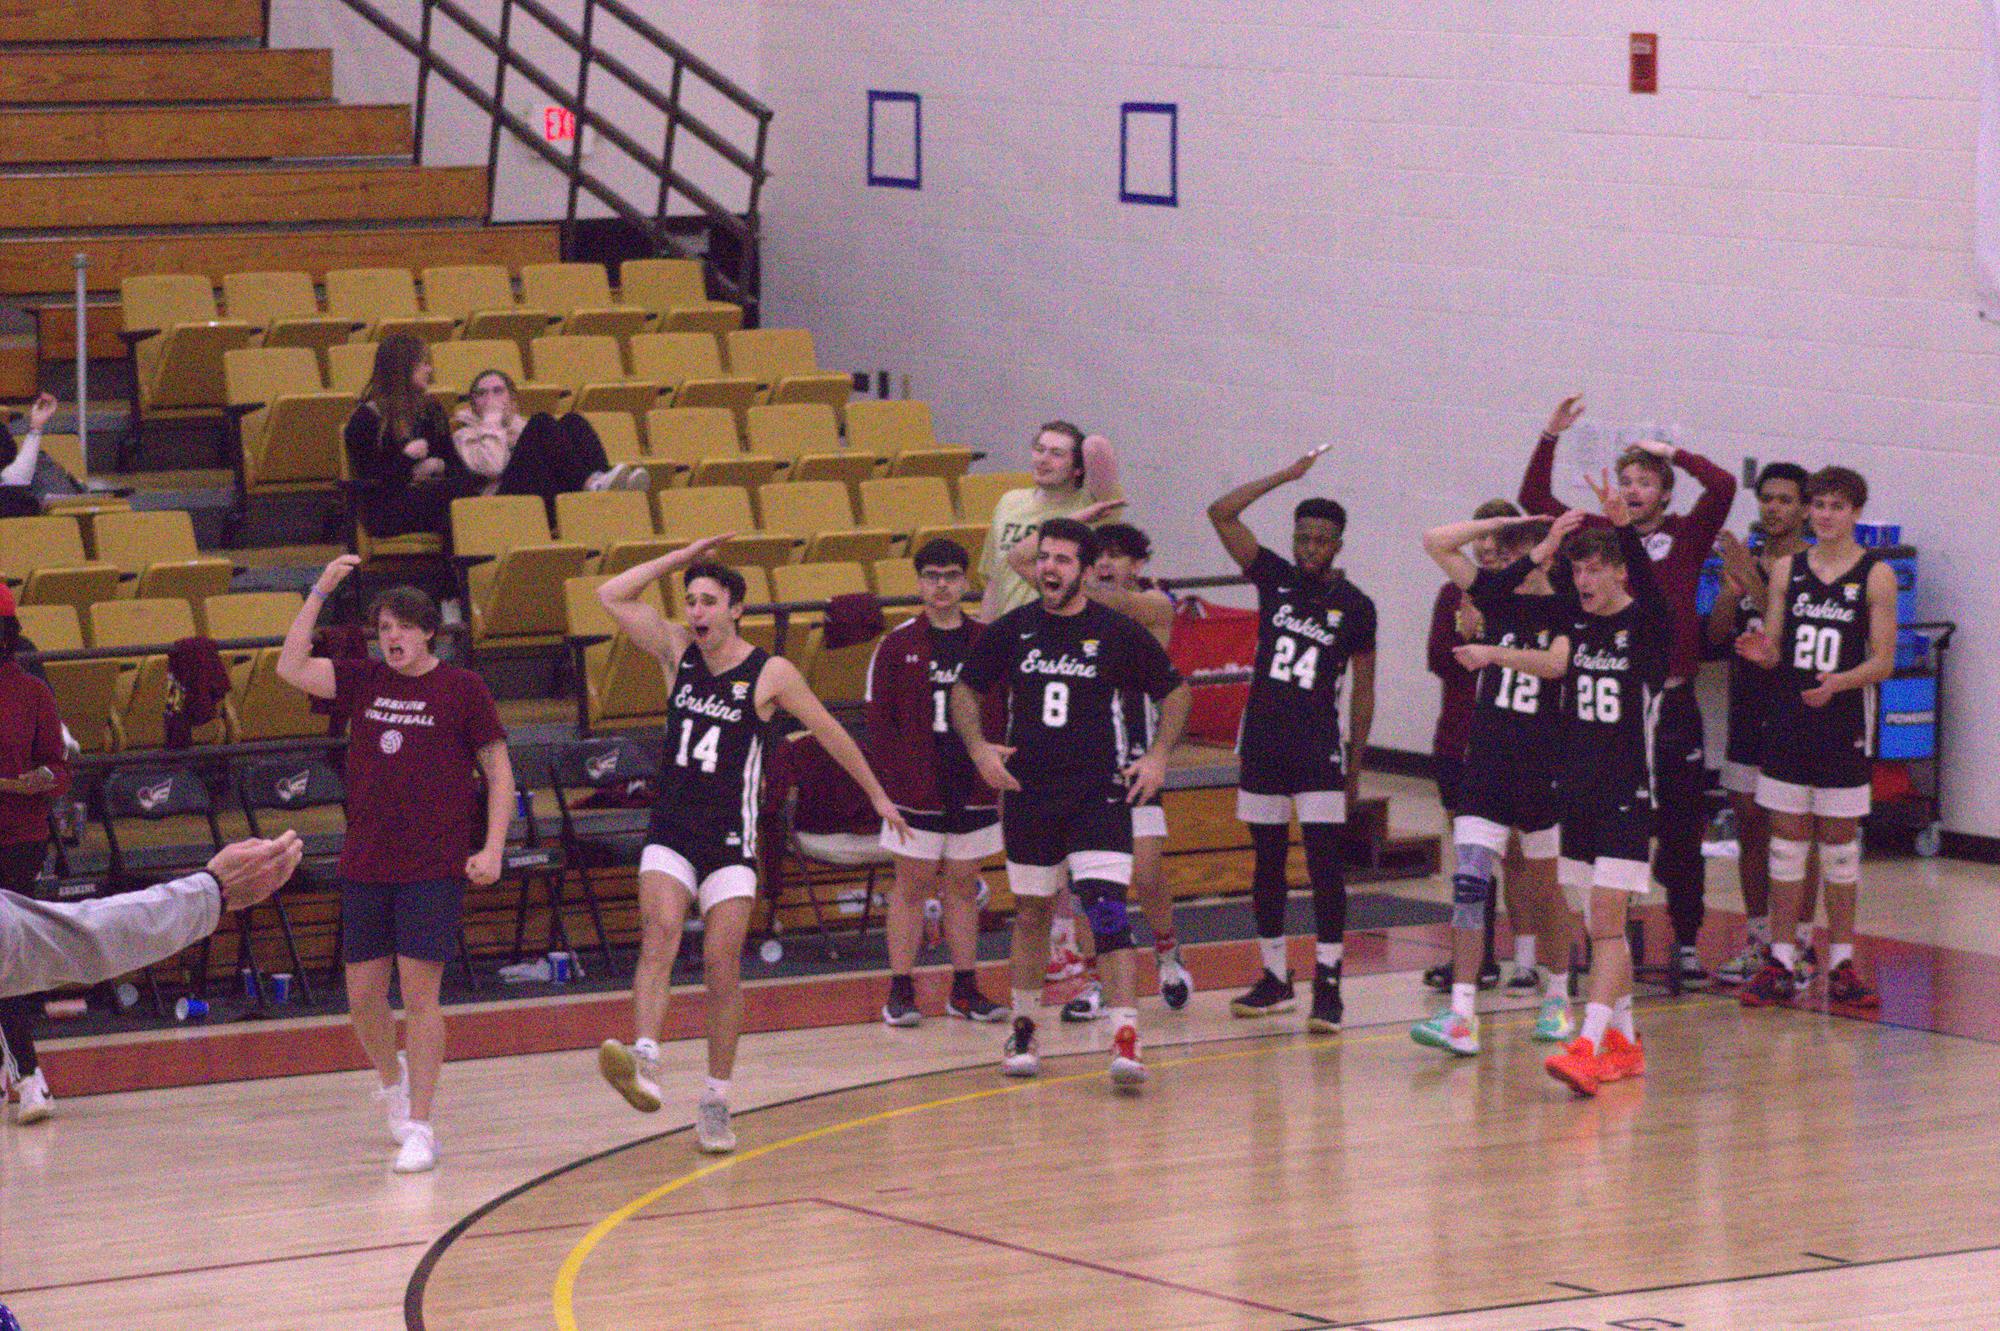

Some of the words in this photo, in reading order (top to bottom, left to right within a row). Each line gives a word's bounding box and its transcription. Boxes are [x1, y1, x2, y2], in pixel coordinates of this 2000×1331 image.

[544, 106, 576, 142] EXI
[1272, 604, 1335, 646] Erskine
[1792, 592, 1855, 623] Erskine
[1020, 648, 1098, 678] Erskine
[1269, 635, 1319, 690] 24
[1573, 643, 1630, 671] Erskine
[1793, 623, 1842, 673] 20
[675, 683, 742, 722] Erskine
[1042, 681, 1069, 727] 8
[1495, 667, 1539, 714] 12
[1577, 674, 1620, 723] 26
[365, 708, 435, 726] VOLLEYBALL
[676, 718, 721, 773] 14
